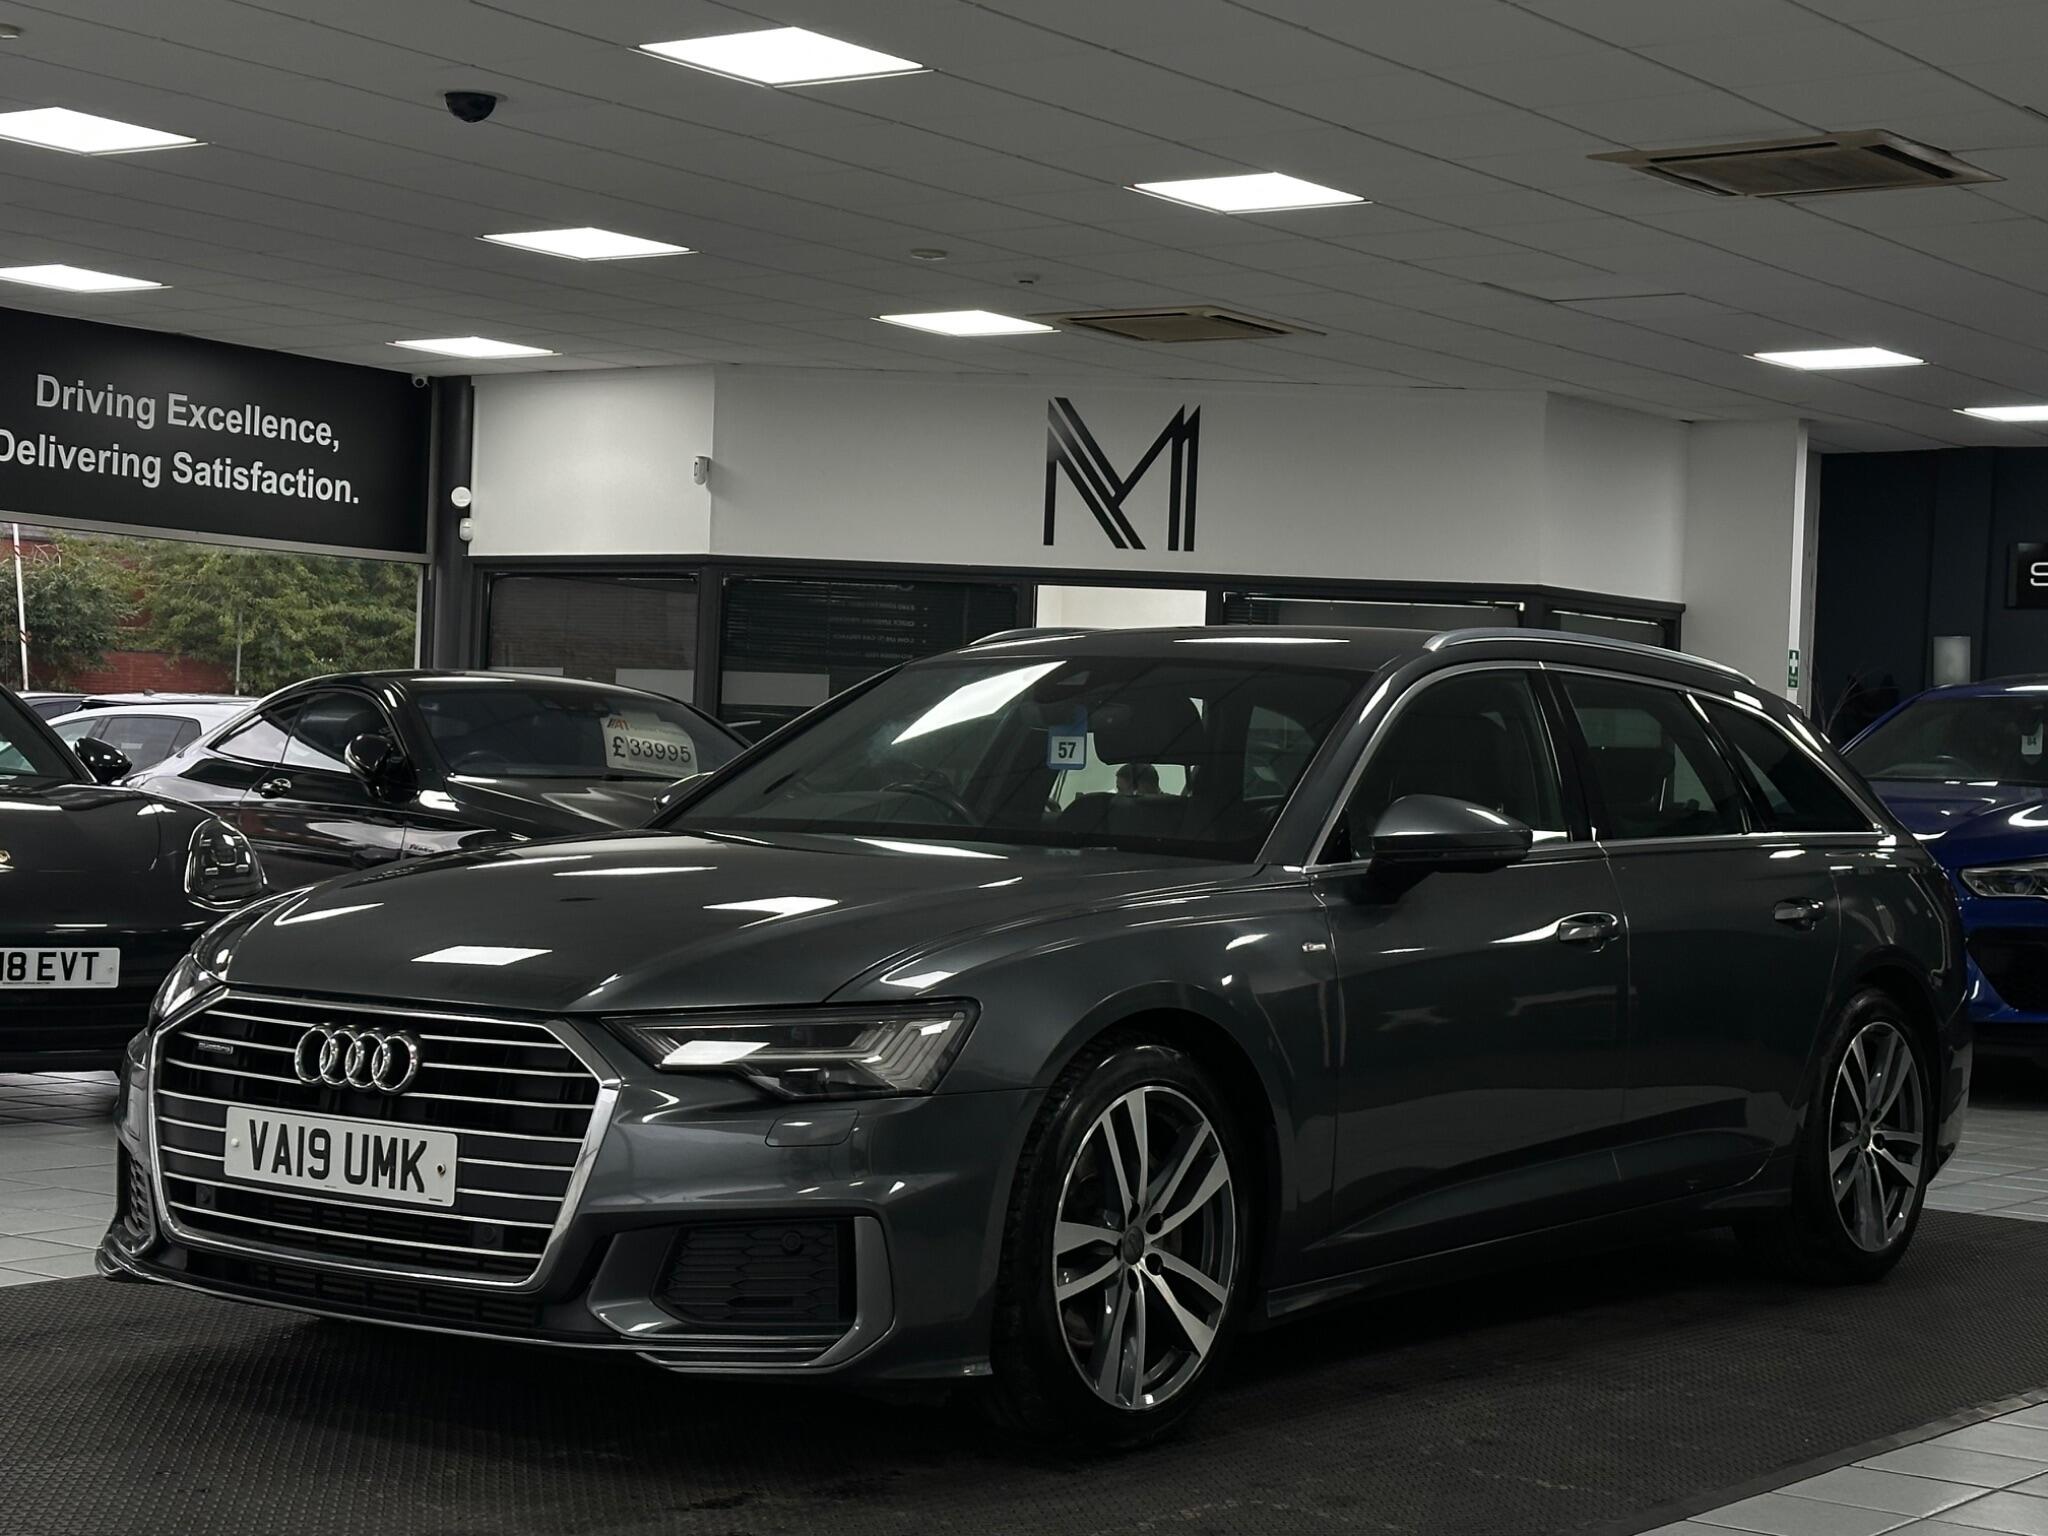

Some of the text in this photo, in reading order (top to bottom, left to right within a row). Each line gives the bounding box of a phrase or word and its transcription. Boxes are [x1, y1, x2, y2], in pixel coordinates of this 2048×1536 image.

[36, 373, 340, 453] Driving Excellence,
[0, 428, 360, 504] Delivering Satisfaction.
[612, 735, 692, 763] £33995
[1057, 741, 1077, 759] 57
[37, 951, 100, 981] EVT
[248, 1118, 428, 1194] VA19 UMK
